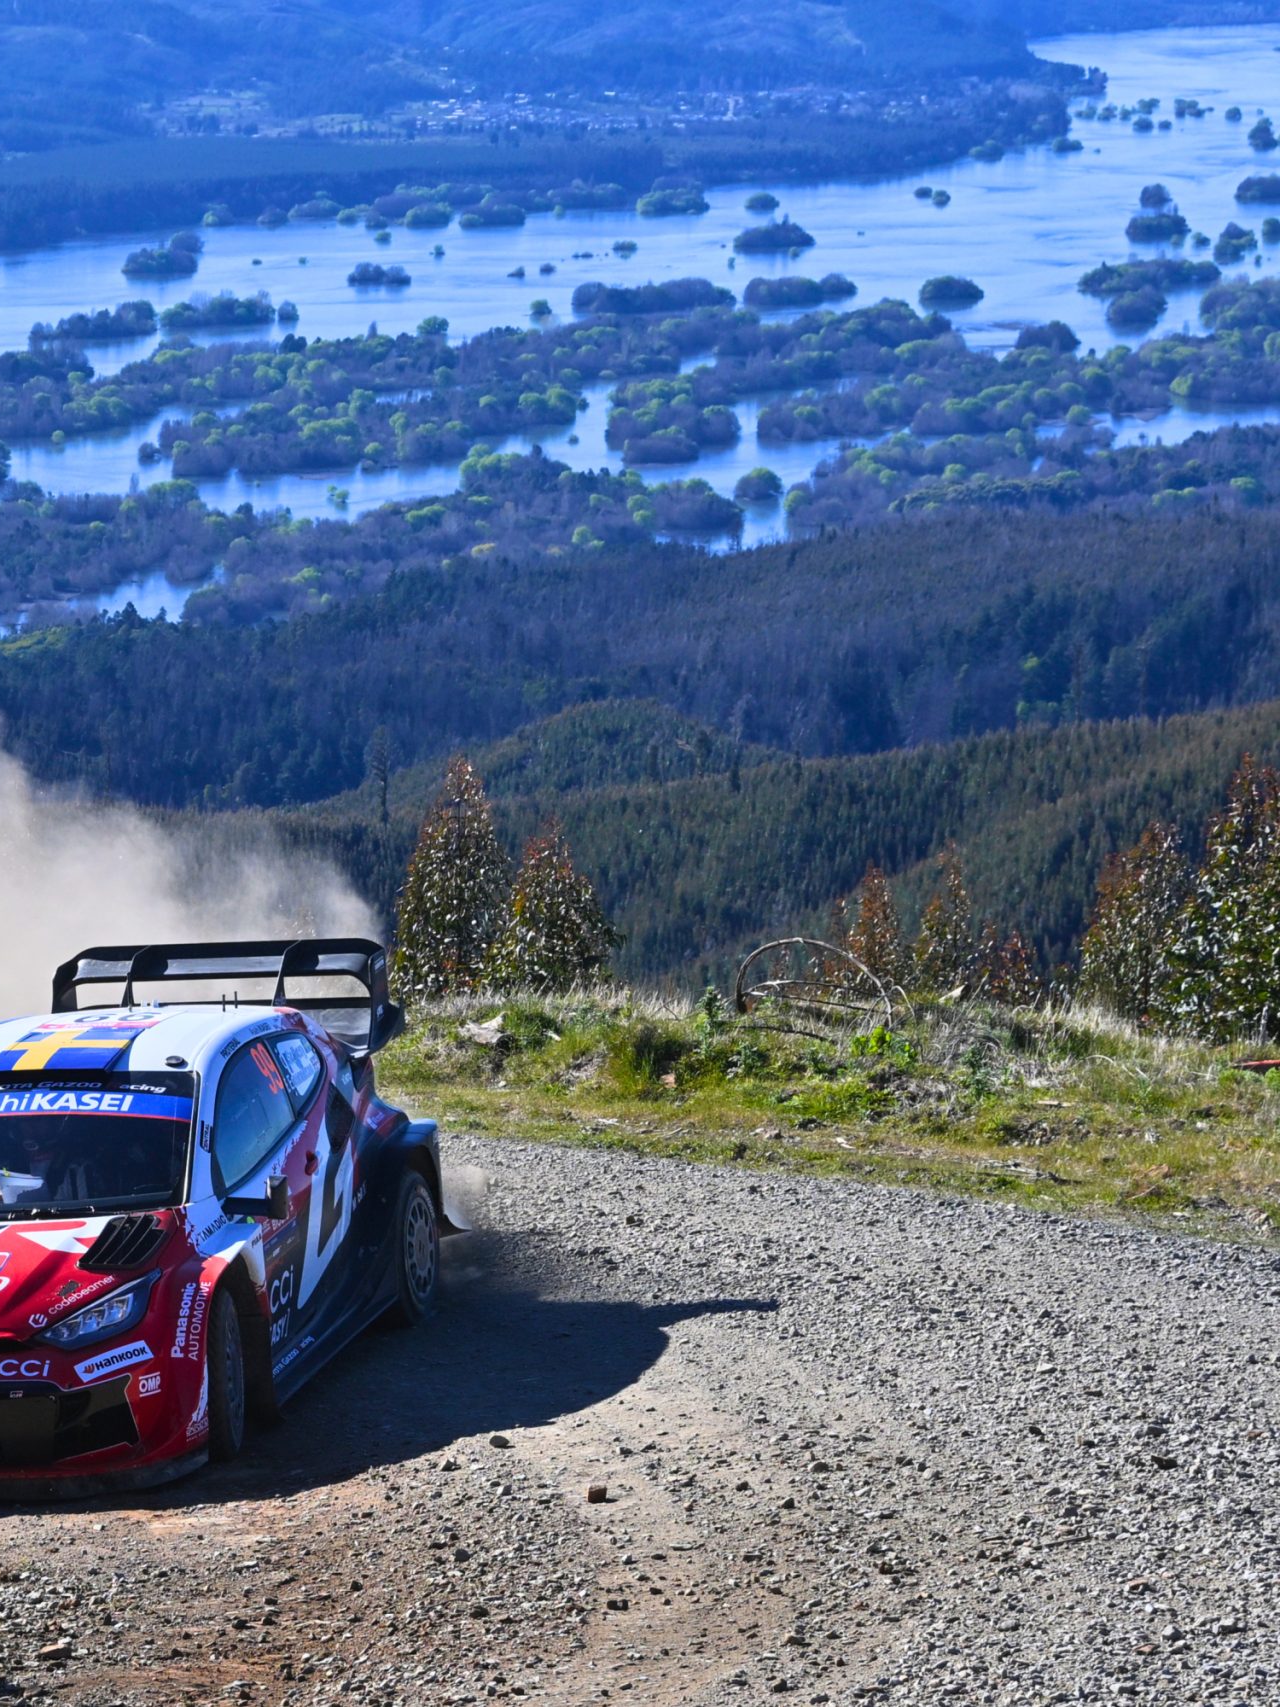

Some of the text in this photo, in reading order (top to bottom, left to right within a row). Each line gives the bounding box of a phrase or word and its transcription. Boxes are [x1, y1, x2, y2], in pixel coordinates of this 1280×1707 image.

[199, 1215, 227, 1242] TAMADIC
[48, 1274, 116, 1315] codebeamer
[171, 1282, 197, 1358] Panasonic
[188, 1281, 212, 1361] AUTOMOTIVE
[139, 1374, 161, 1395] OMP
